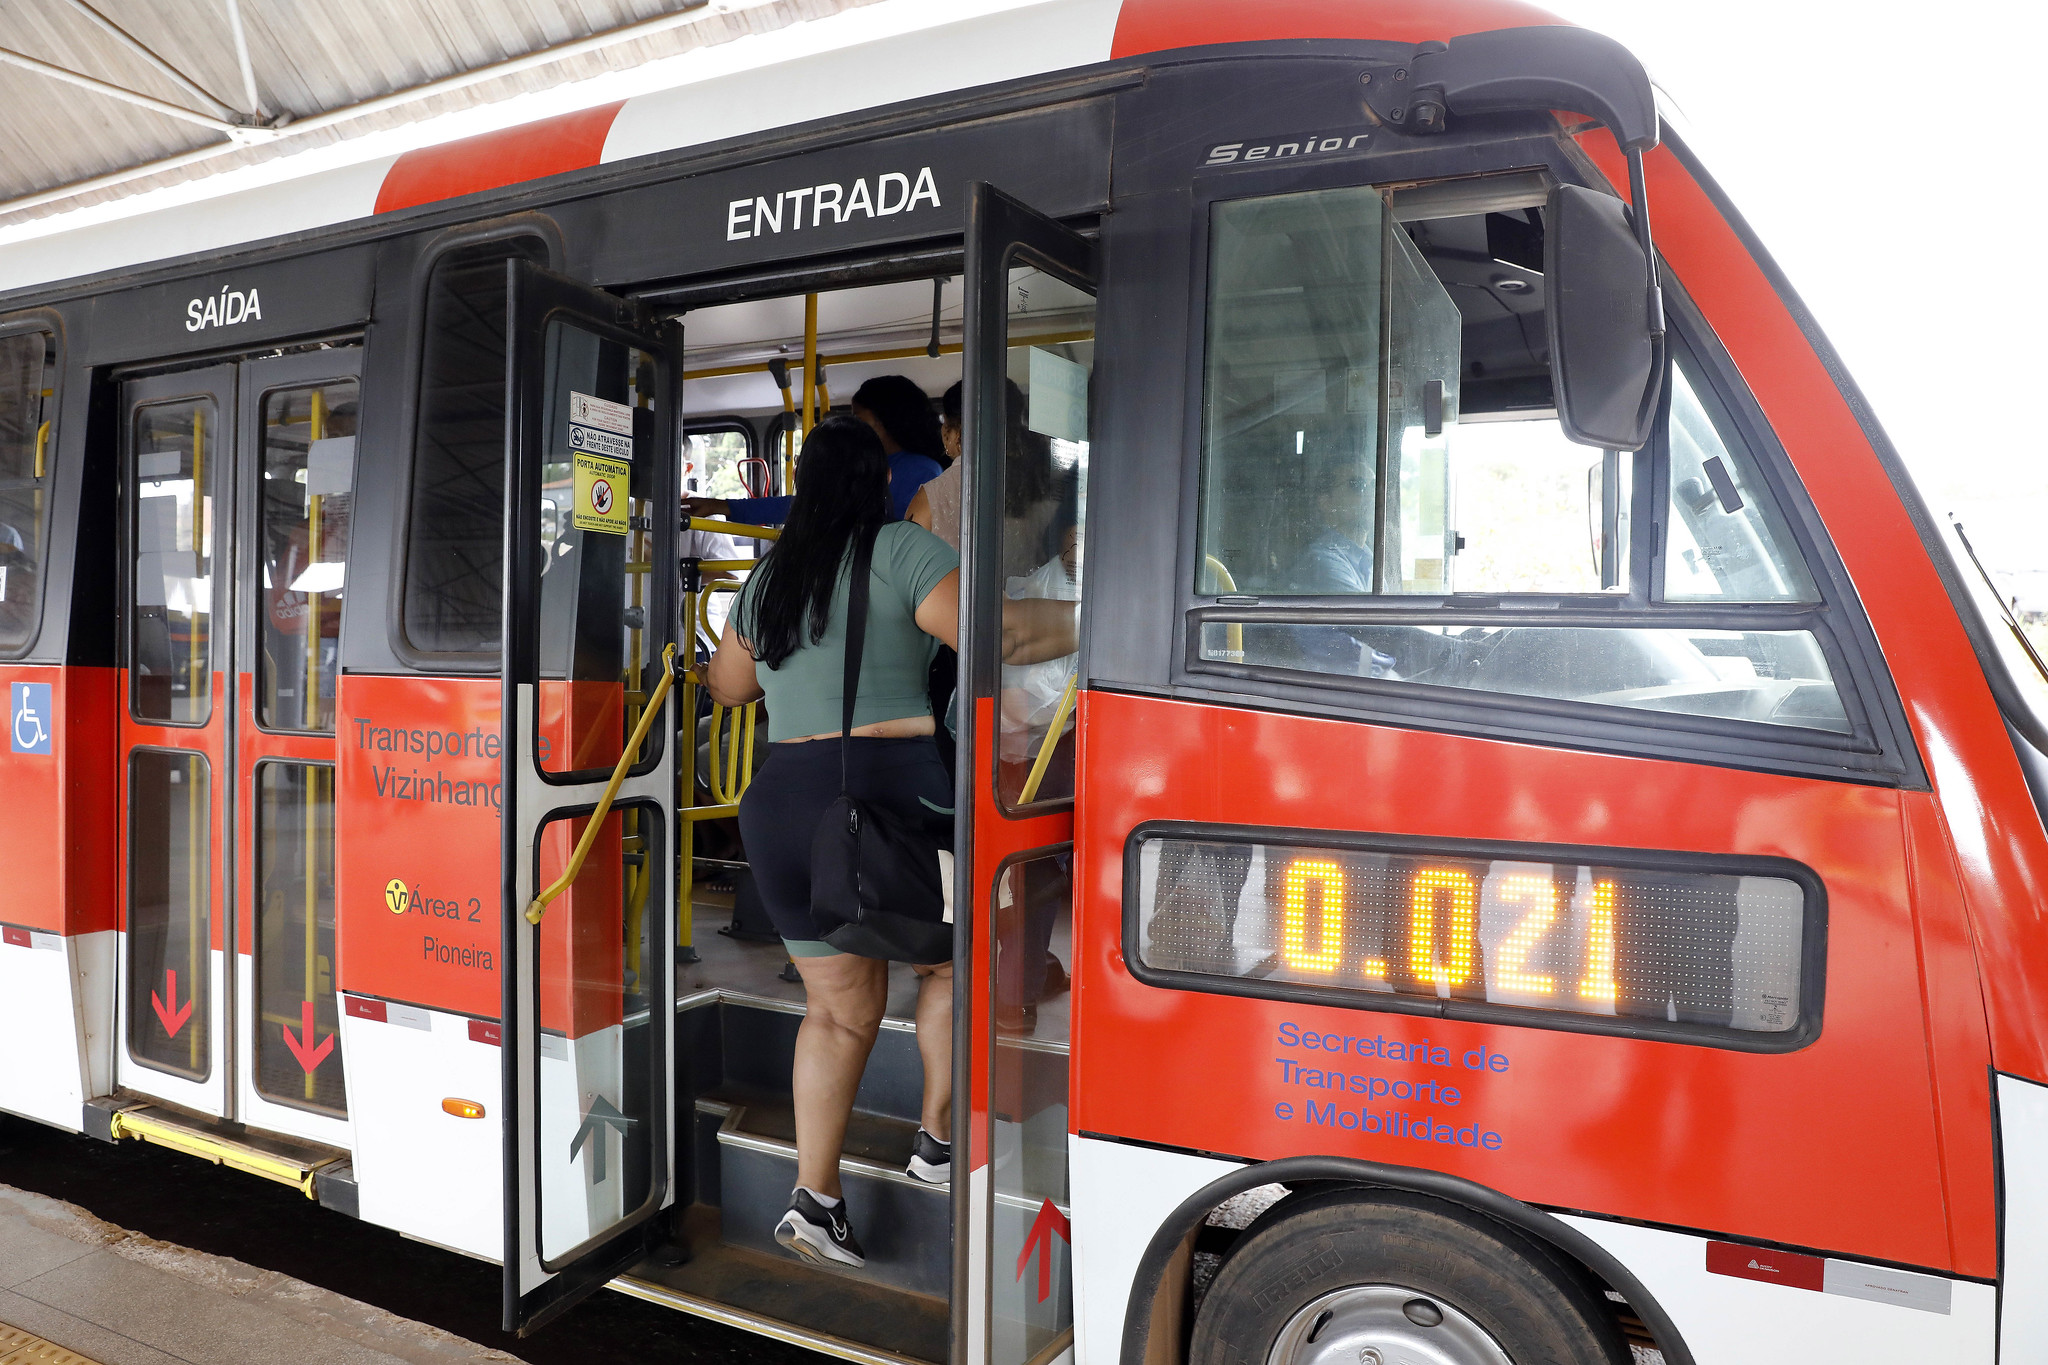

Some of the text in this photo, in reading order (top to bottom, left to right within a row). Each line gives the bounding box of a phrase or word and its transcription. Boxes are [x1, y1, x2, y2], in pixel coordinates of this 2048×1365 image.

[1205, 134, 1369, 165] Senior
[727, 167, 941, 241] ENTRADA
[185, 285, 262, 332] SAÍDA
[586, 431, 631, 449] NÃO ATRAVESSE NA
[586, 440, 601, 451] FRENTE
[601, 443, 613, 454] DESTE
[576, 458, 594, 470] PORTA
[275, 603, 309, 619] adida
[353, 717, 502, 762] Transporte
[372, 765, 502, 817] Vizinhanç
[408, 883, 482, 923] Área 2
[1284, 860, 1617, 999] 0.021
[423, 936, 494, 971] Pioneira
[1277, 1021, 1510, 1073] Secretaria de
[1275, 1058, 1462, 1106] Transporte
[1274, 1099, 1503, 1151] e Mobilidade
